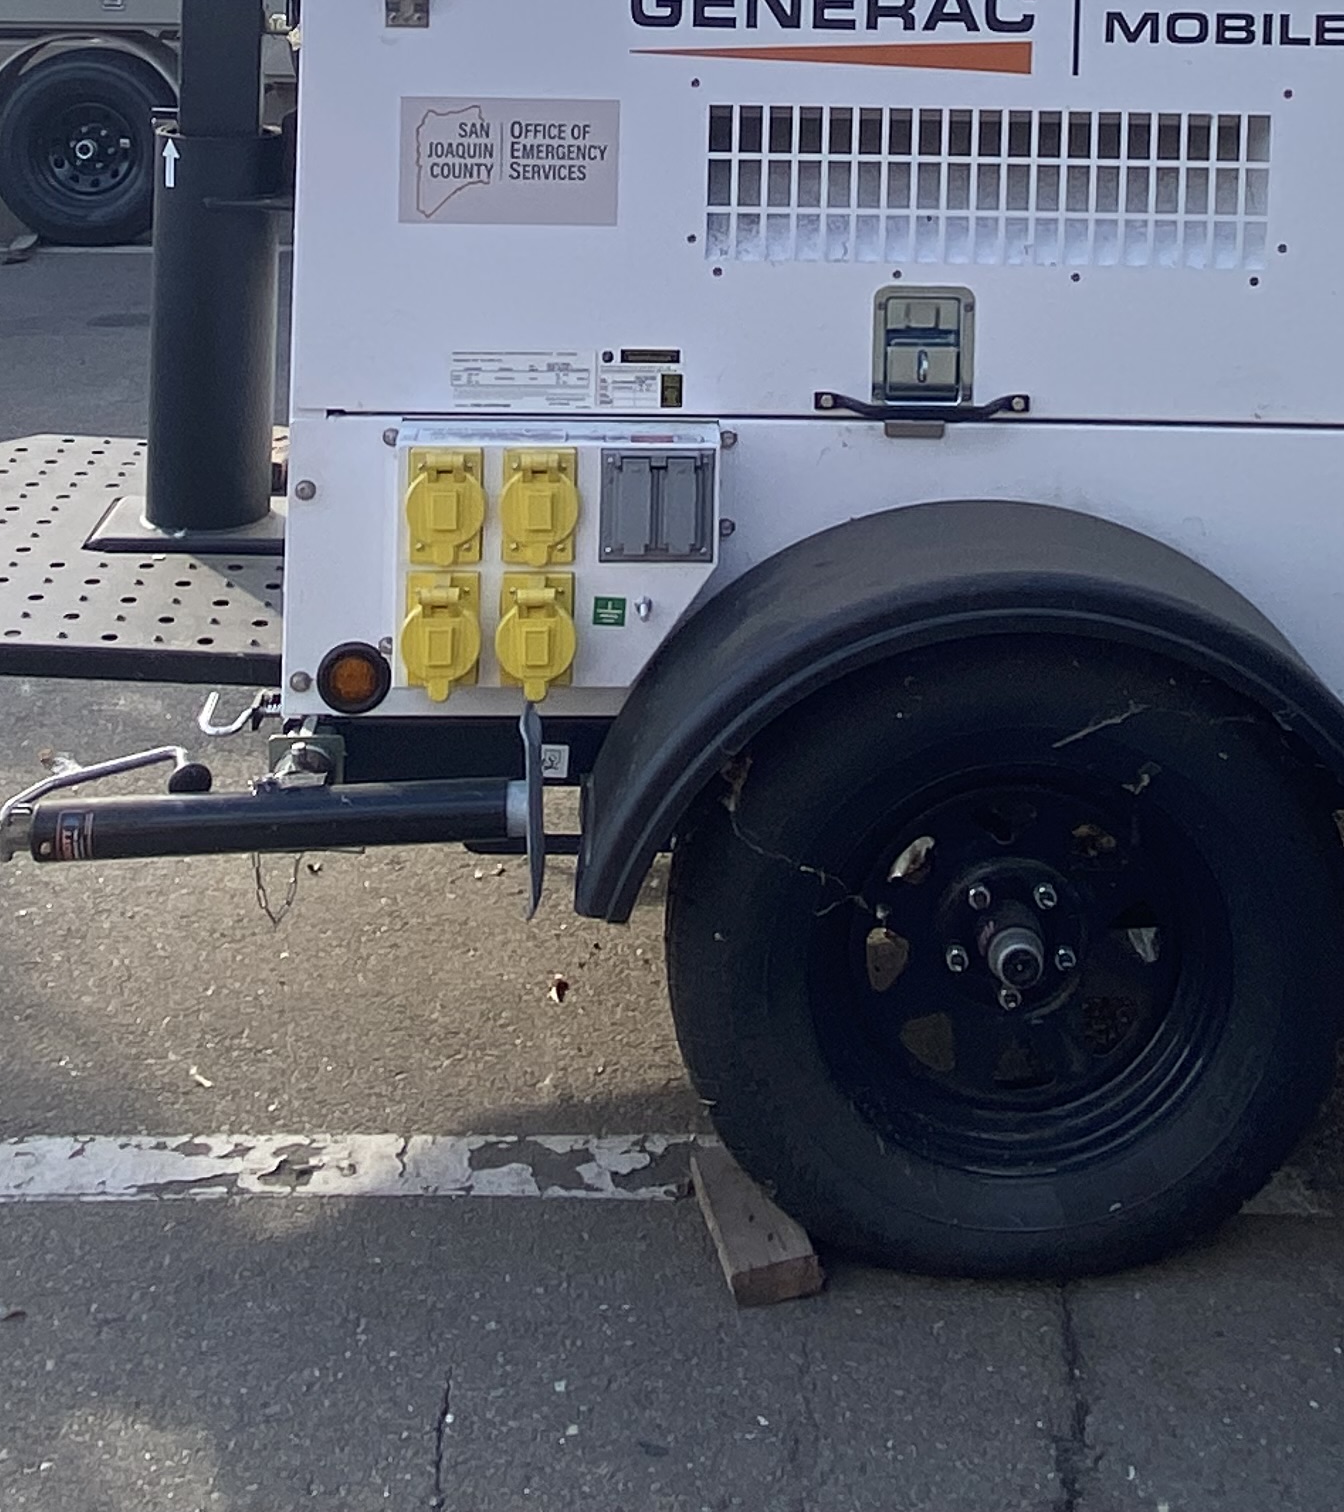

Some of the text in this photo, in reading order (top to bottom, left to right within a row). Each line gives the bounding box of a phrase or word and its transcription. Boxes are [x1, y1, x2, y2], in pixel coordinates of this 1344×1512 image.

[458, 121, 491, 139] SAN
[509, 120, 592, 141] OFFICE OF
[427, 141, 494, 160] JOAQUIN
[509, 141, 608, 162] EMERGENCY
[430, 162, 494, 180] COUNTY
[508, 161, 587, 182] SERVICES
